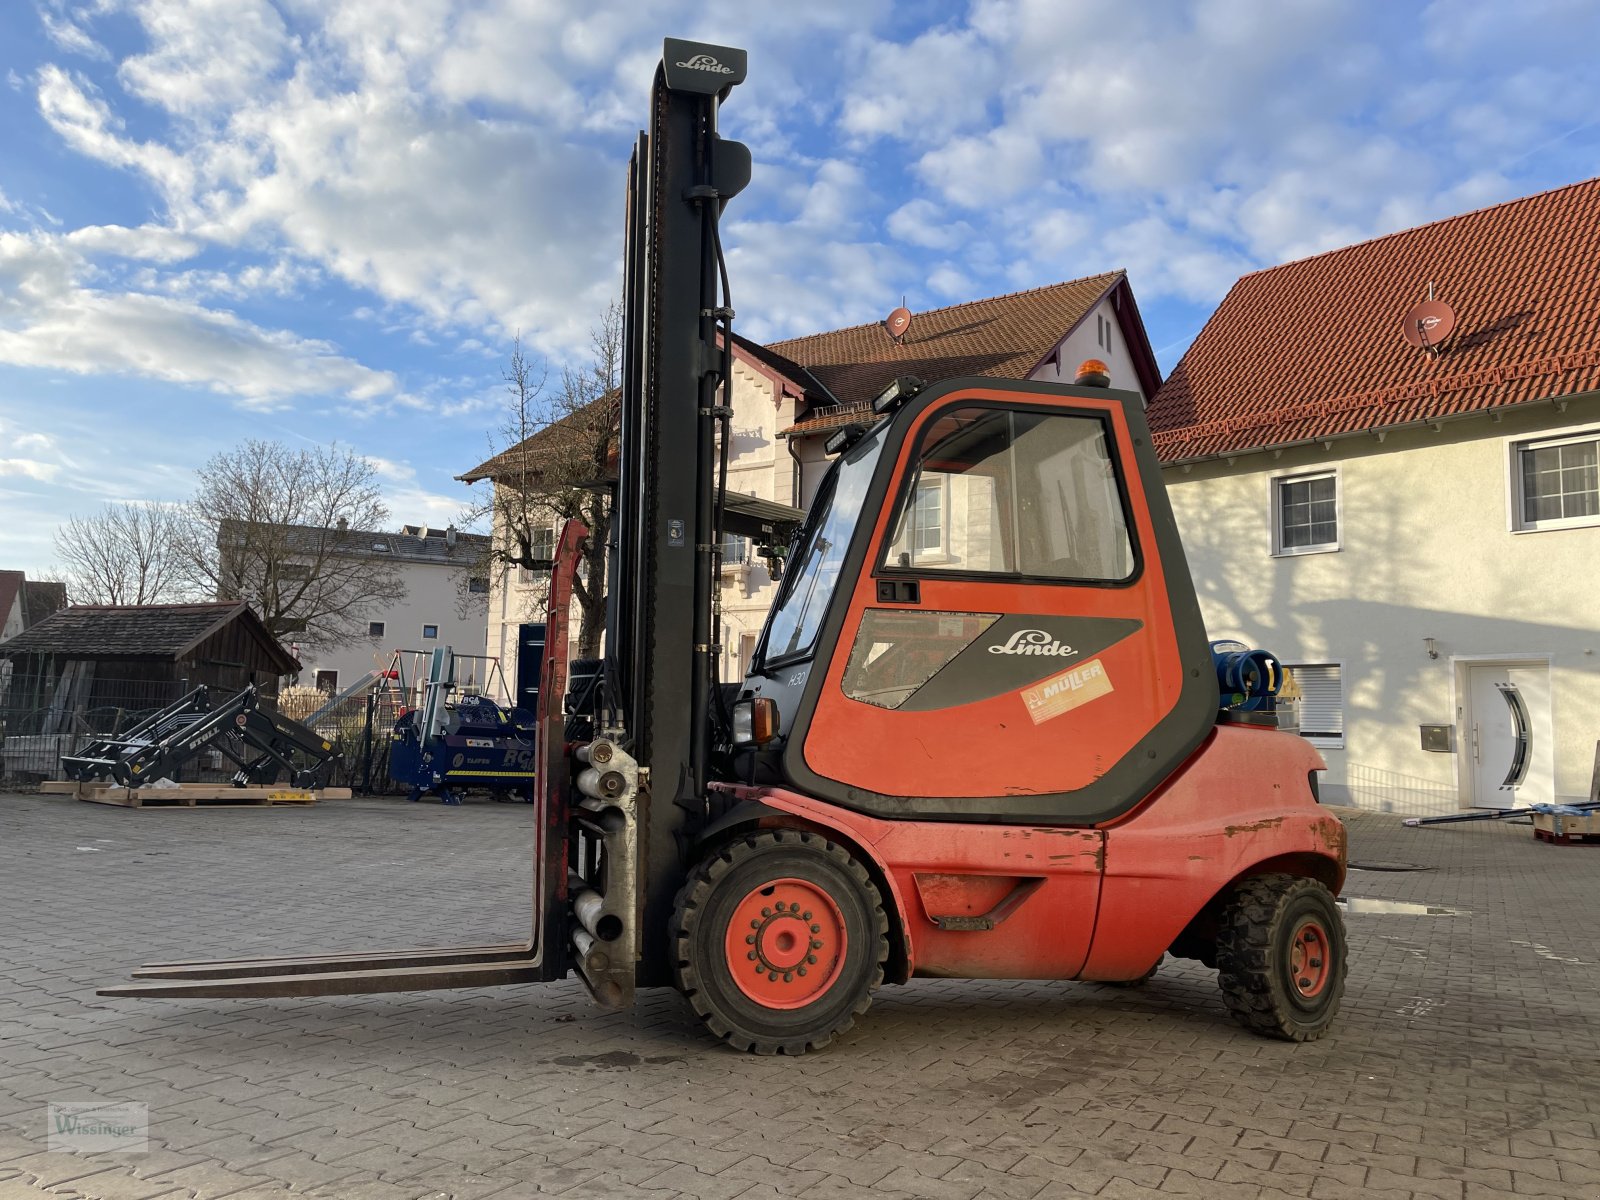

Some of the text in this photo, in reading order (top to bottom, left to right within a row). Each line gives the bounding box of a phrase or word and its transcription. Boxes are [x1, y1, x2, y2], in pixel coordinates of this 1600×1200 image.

[675, 54, 735, 75] Linde
[988, 629, 1079, 657] Linde
[503, 749, 536, 765] RC
